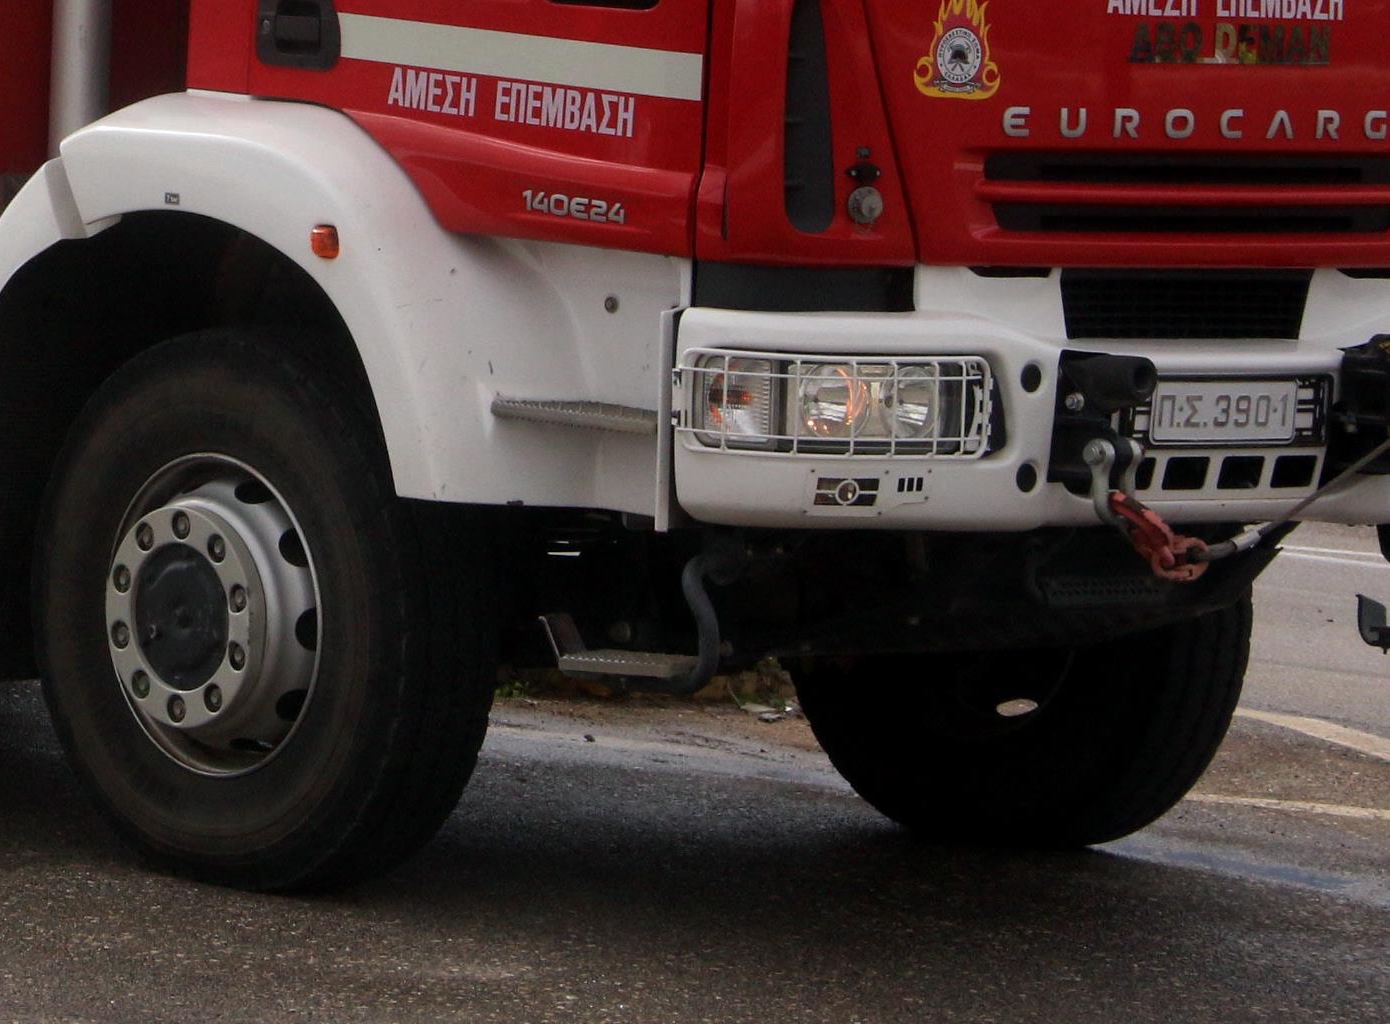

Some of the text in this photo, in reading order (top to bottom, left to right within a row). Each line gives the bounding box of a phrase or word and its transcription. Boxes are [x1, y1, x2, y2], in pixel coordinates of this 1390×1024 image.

[387, 67, 635, 138] ΑΜΕΣΗ ΕΠΕΜΒΑΣΗ
[522, 189, 626, 225] 140E24
